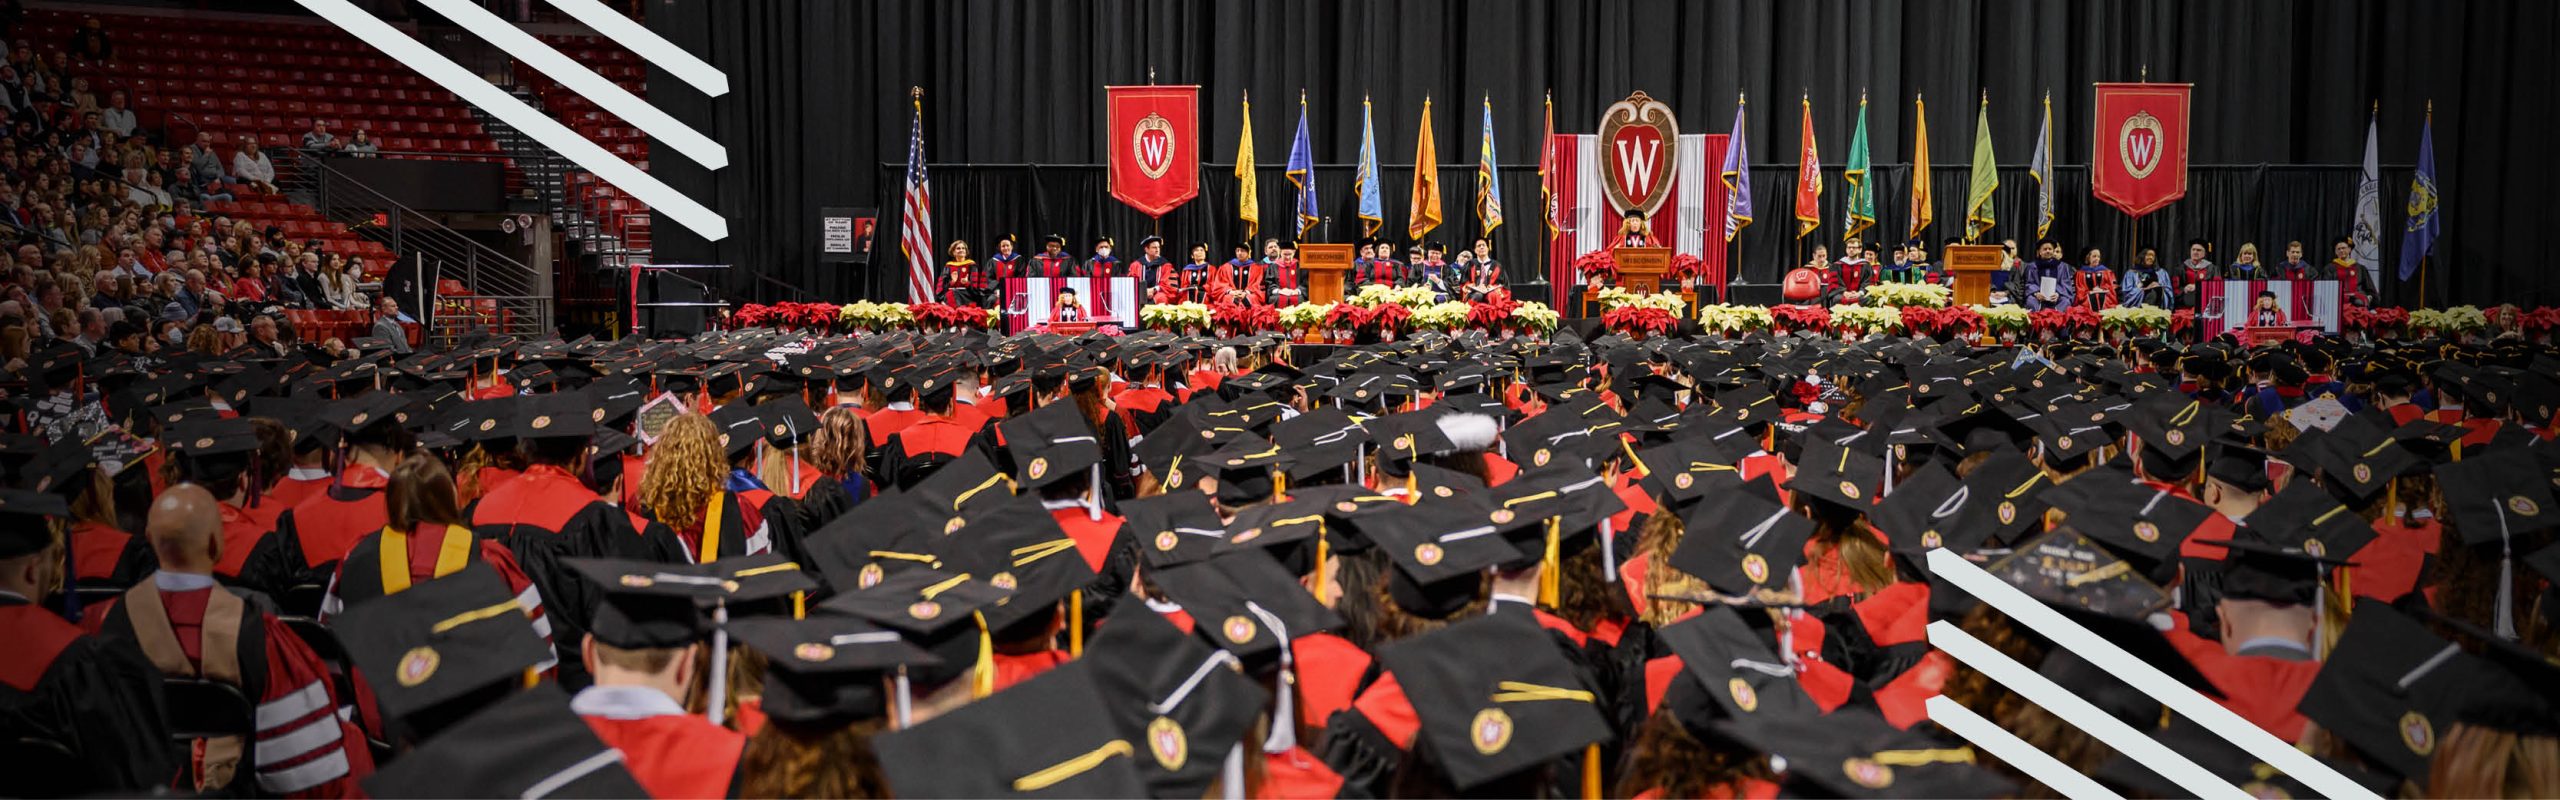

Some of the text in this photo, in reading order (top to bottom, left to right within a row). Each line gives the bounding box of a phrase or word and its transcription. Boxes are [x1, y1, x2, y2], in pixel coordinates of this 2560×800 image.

[1143, 135, 1165, 166] W
[2130, 133, 2153, 166] W
[1616, 135, 1660, 196] W
[1306, 253, 1345, 261] WISCONSIN
[1796, 270, 1808, 280] W
